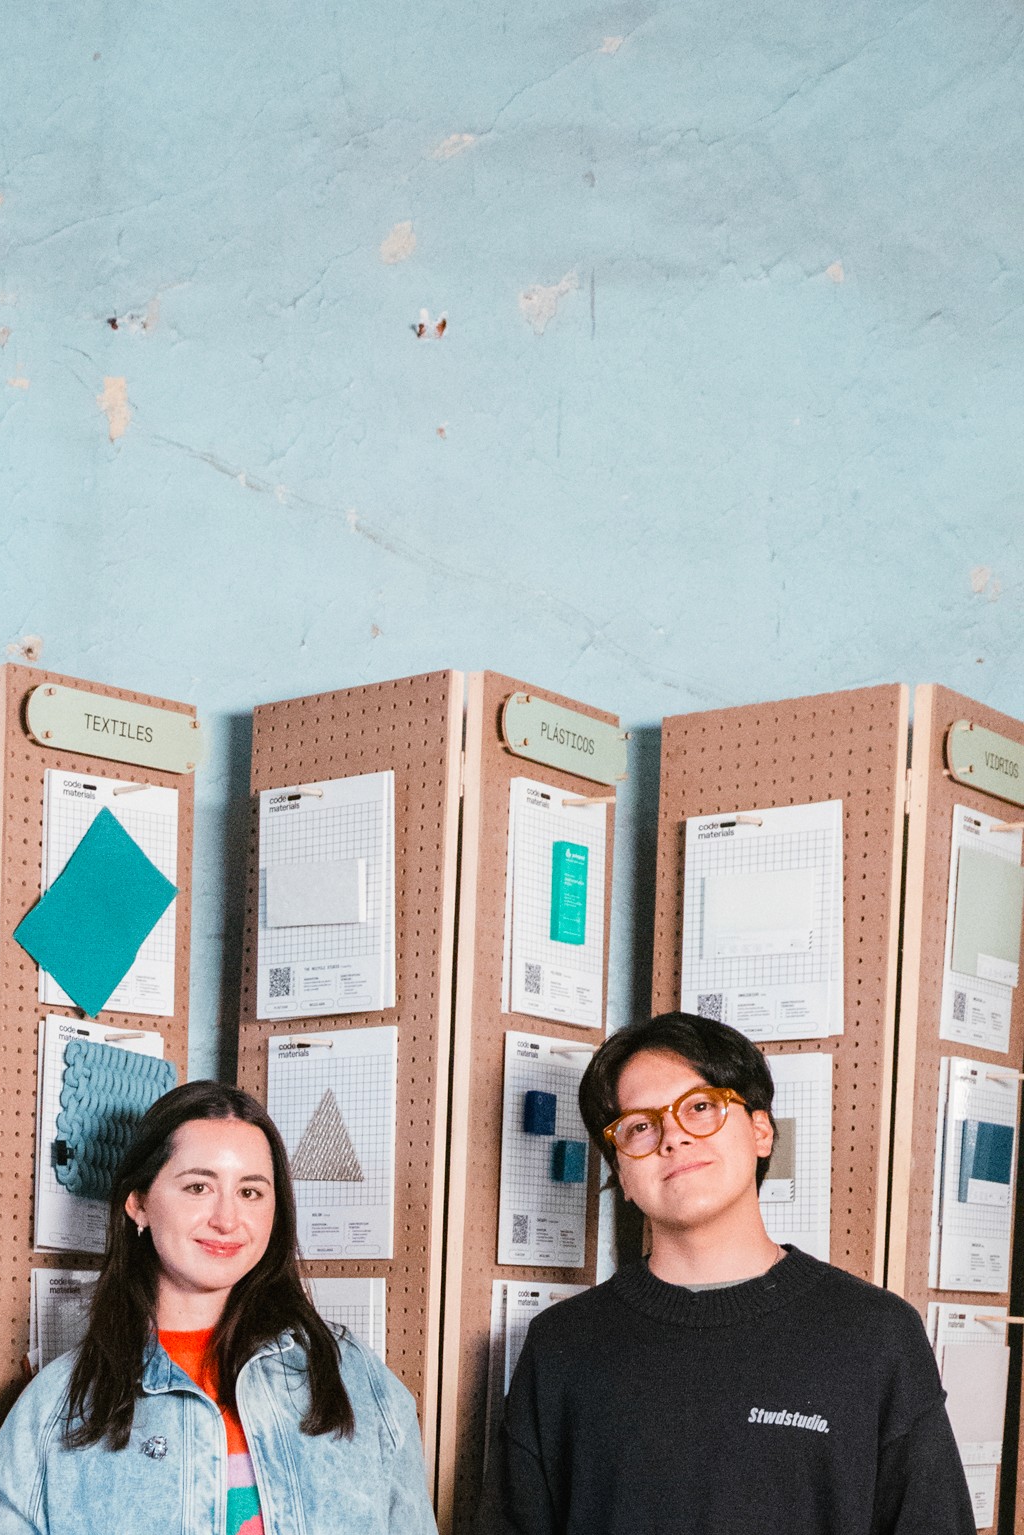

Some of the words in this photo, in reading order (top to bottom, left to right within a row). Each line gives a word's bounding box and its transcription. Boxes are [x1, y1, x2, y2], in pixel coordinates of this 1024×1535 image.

[84, 713, 153, 742] TEXTILES
[541, 721, 595, 756] PLÁSTICOS
[985, 751, 1019, 779] VIDRIOS
[63, 780, 82, 789] code
[63, 788, 95, 799] materials
[526, 788, 540, 797] code
[269, 795, 286, 804] code
[269, 802, 300, 812] materials
[698, 821, 719, 831] code
[698, 828, 735, 839] materials
[59, 1025, 75, 1033] code
[278, 1049, 309, 1059] materials
[748, 1407, 830, 1433] Stwdstudio.
